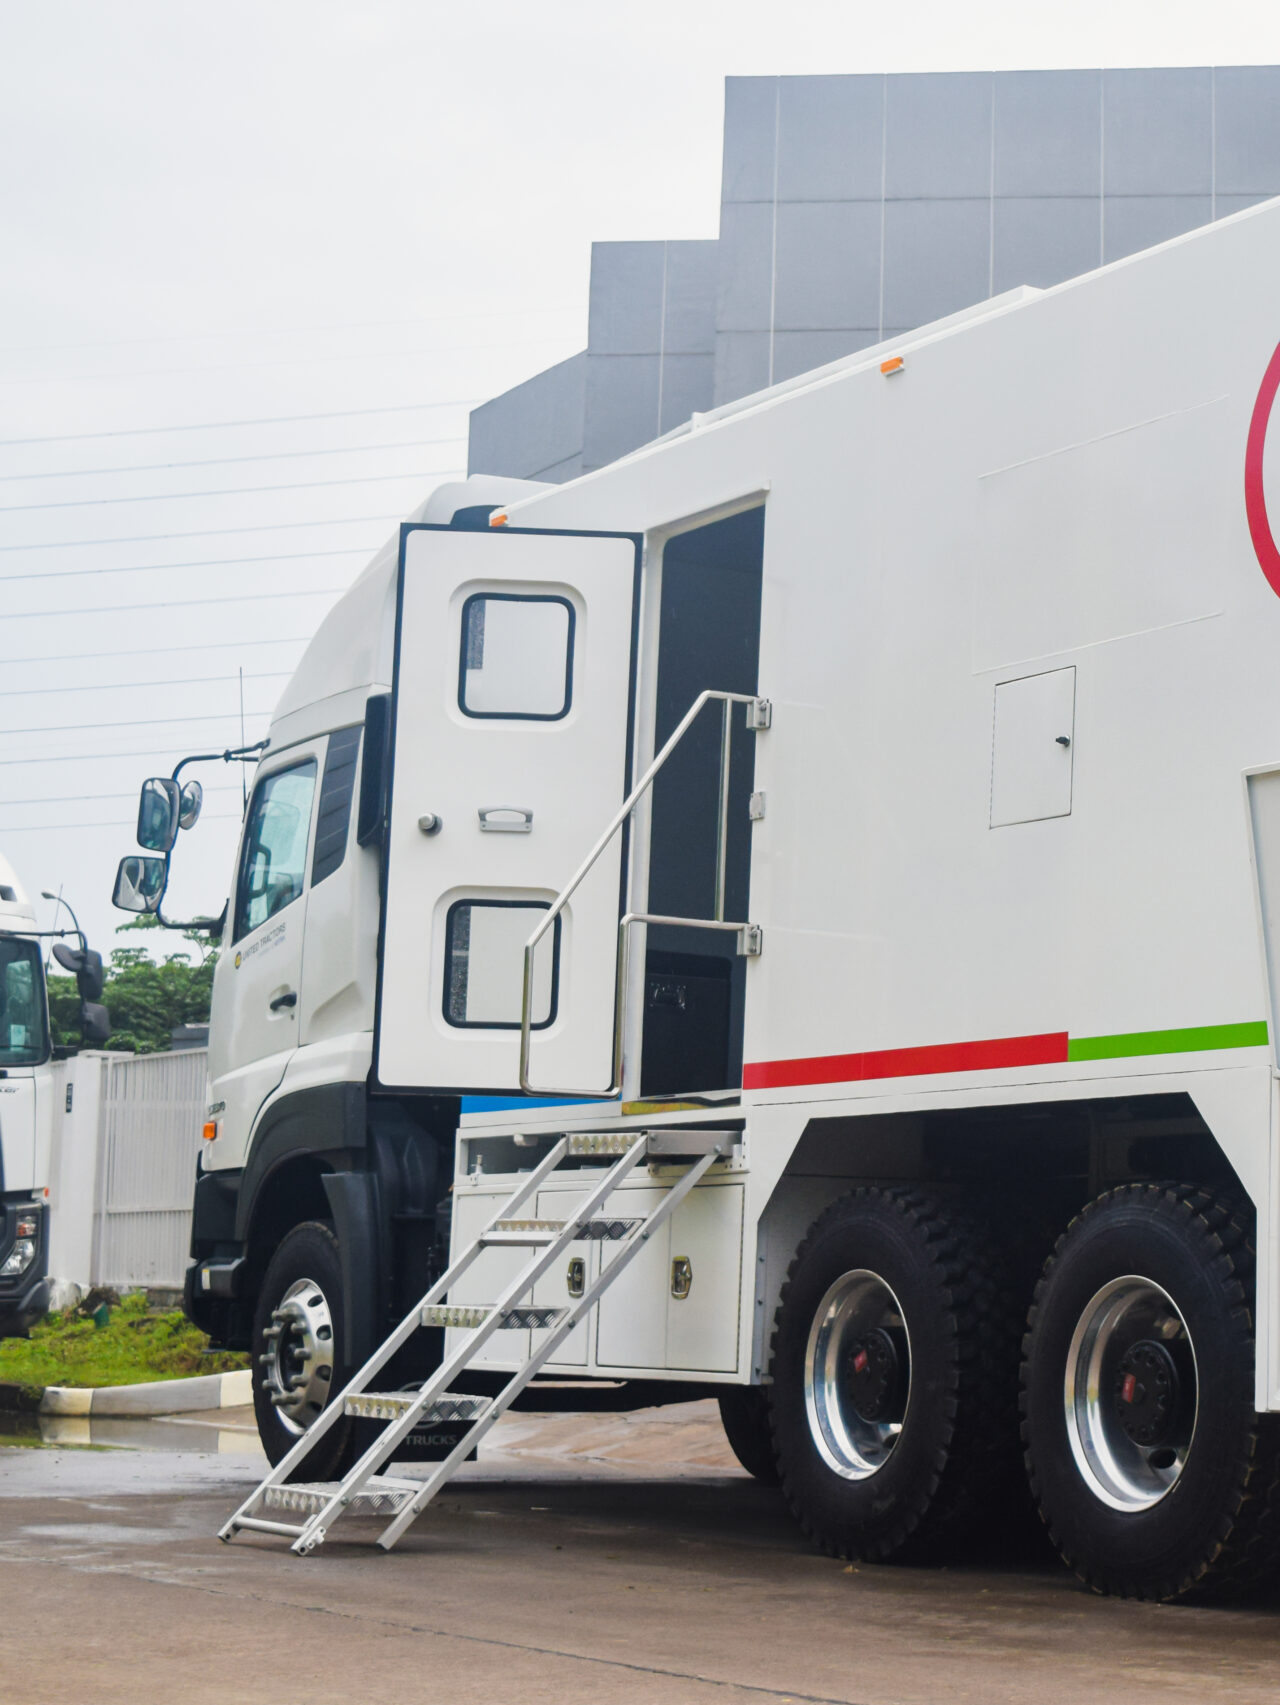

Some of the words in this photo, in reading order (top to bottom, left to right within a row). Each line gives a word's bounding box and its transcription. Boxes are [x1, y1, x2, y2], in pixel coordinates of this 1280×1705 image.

[243, 942, 259, 961] UNITED
[260, 921, 286, 948] TRACTORS
[405, 1435, 457, 1445] TRUCKS
